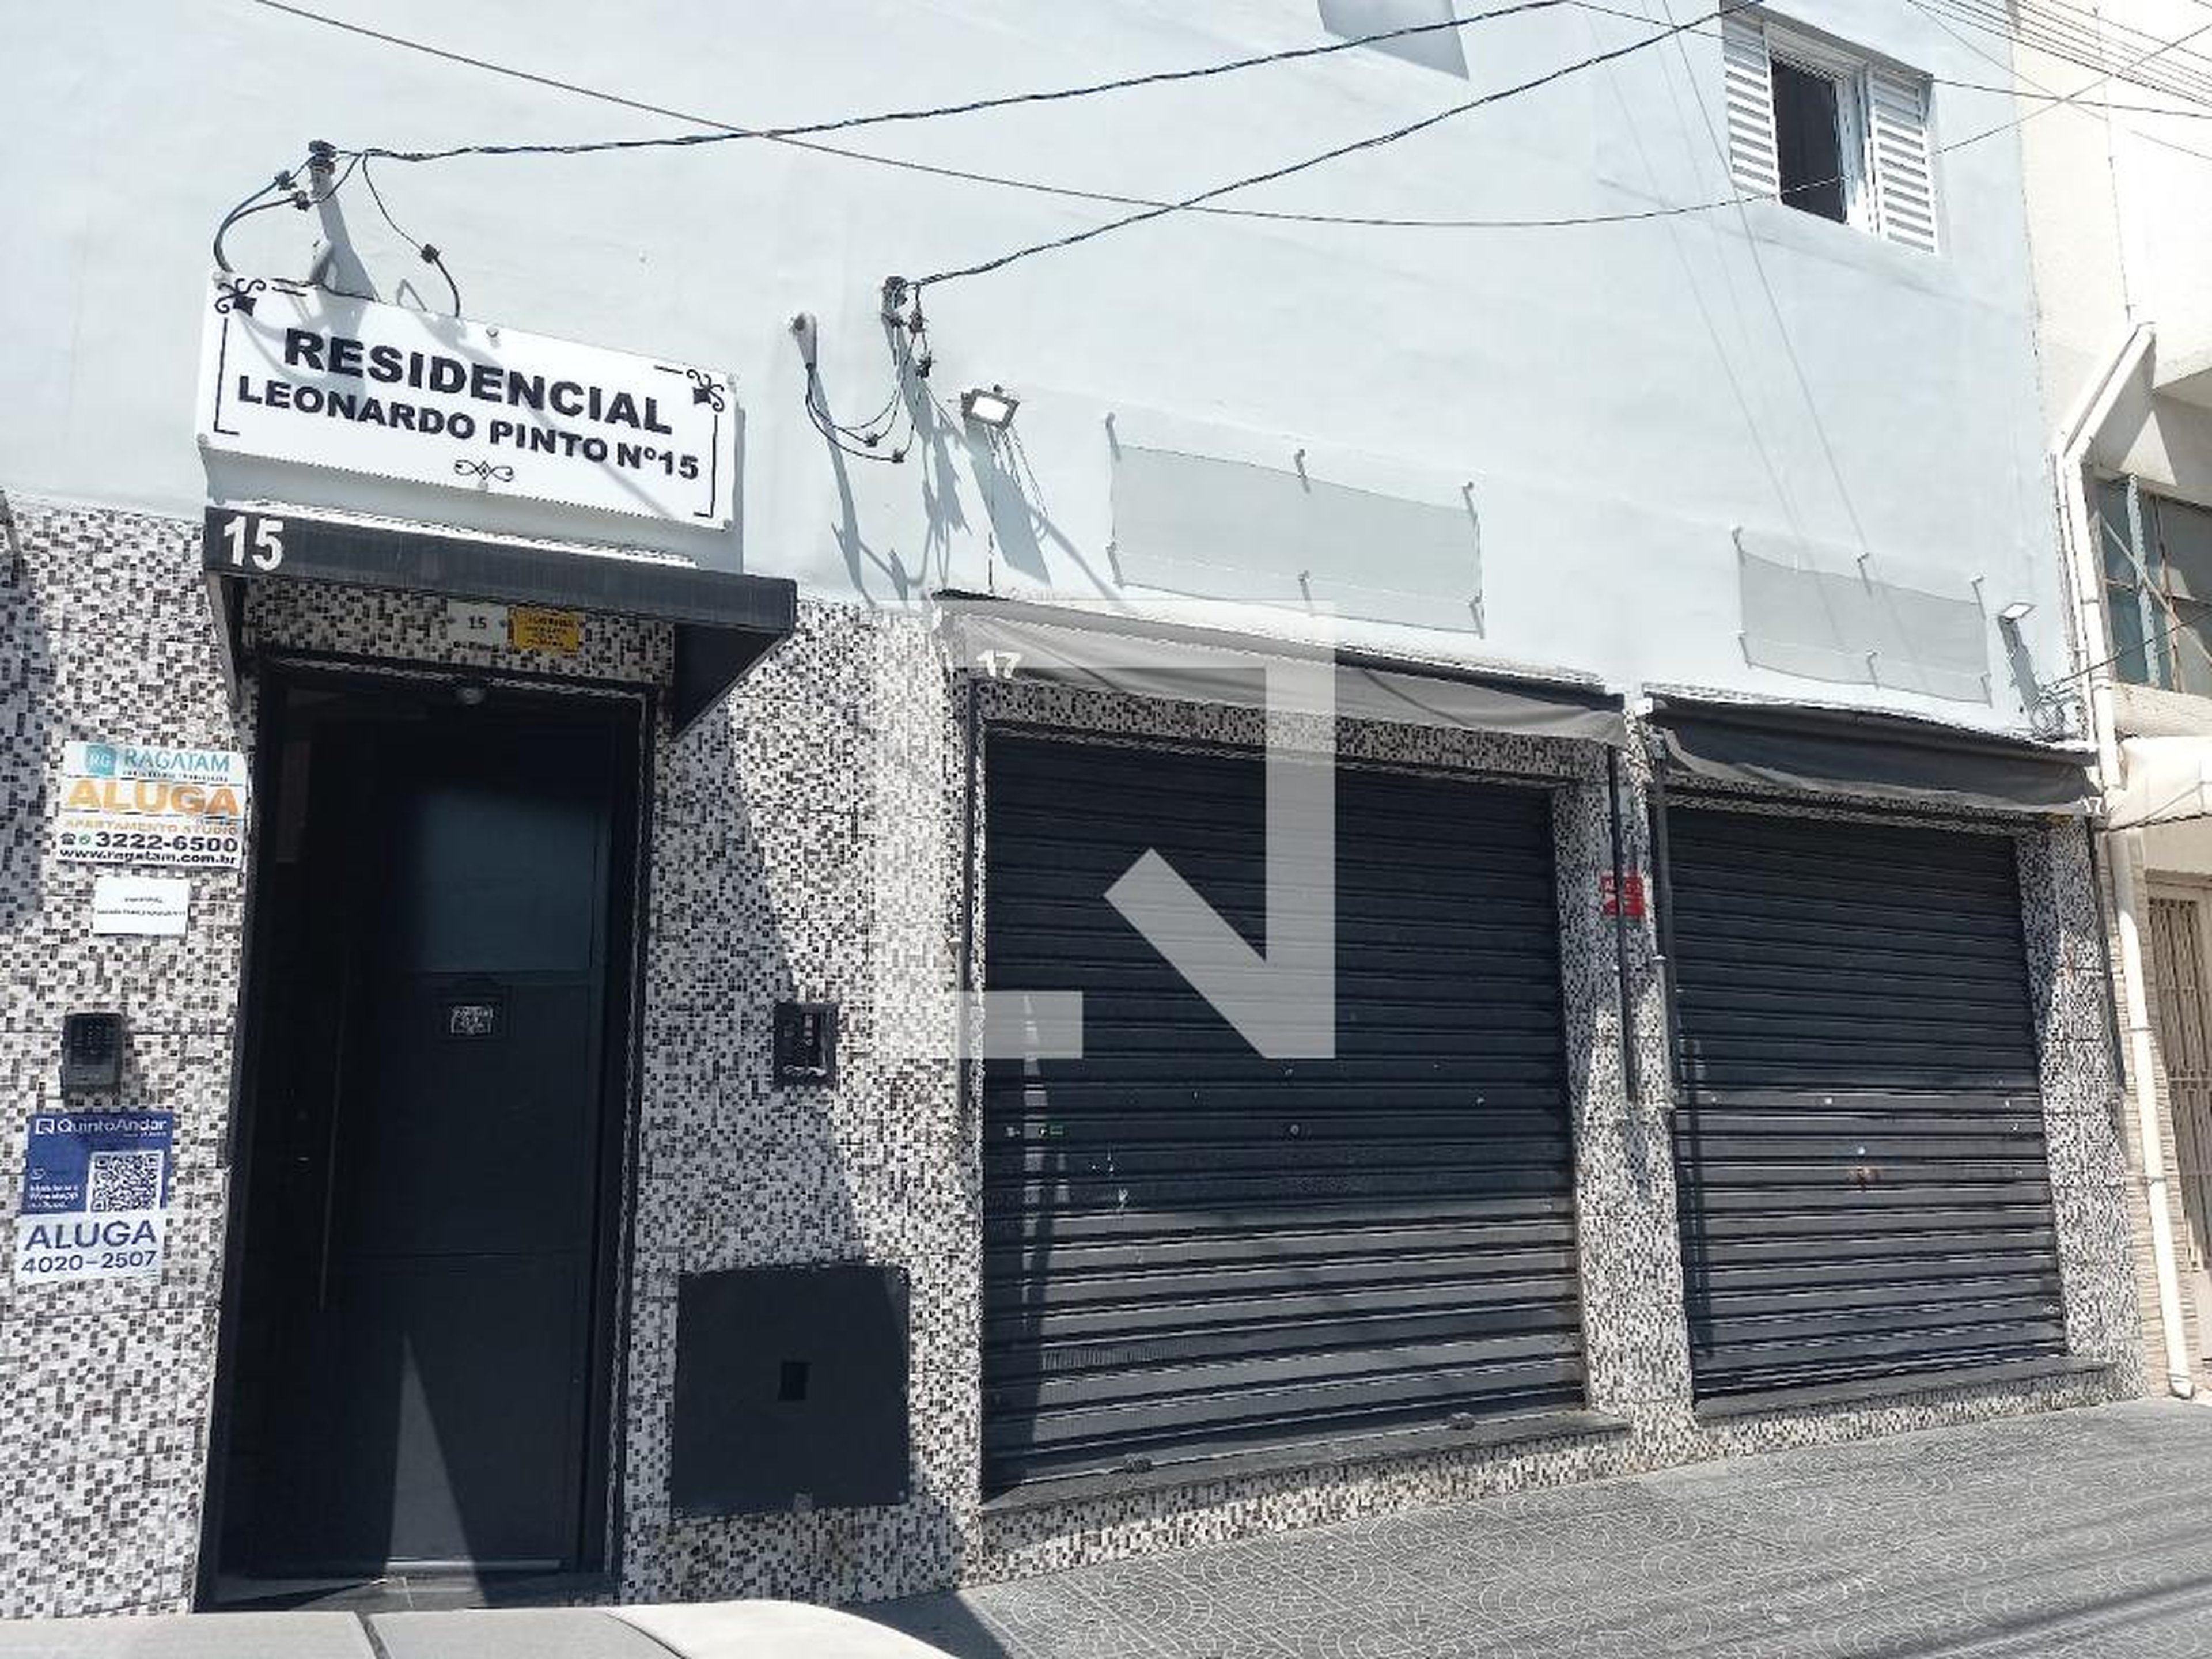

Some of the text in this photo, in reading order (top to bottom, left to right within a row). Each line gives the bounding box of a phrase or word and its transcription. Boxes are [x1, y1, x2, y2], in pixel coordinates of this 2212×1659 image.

[284, 327, 673, 435] RESIDENCIAL
[238, 375, 476, 440] LEONARDO
[490, 419, 608, 463] PINTO
[224, 515, 284, 571] 15
[468, 616, 487, 629] 15
[976, 650, 1020, 679] 17
[123, 749, 230, 772] RAGATAM
[67, 779, 238, 816] ALUGA
[95, 831, 238, 852] 3222-6500
[60, 849, 237, 865] www.ragatam.com.br
[58, 1118, 168, 1133] QuintoAndar
[24, 1219, 157, 1251] ALUGA
[21, 1250, 157, 1274] 4020-2507
